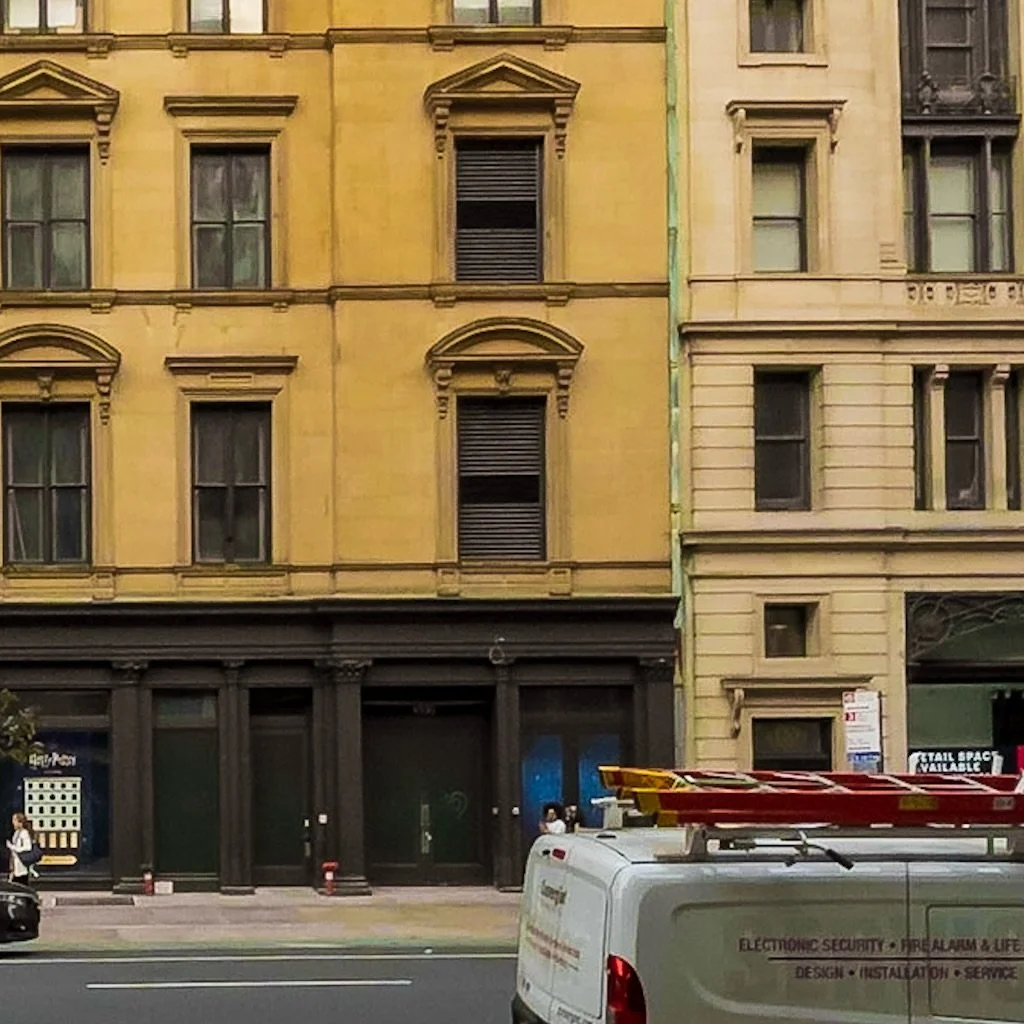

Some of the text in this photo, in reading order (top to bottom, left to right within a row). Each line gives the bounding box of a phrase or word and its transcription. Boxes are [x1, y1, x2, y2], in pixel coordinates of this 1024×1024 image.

[919, 751, 955, 762] ETAIL
[917, 761, 981, 773] VAILABLE
[738, 937, 1022, 952] ELECTRONIC SECURITY FIRE ALARM & LIFE
[795, 965, 1019, 980] DESIGN INSTALLATION SERVICE
